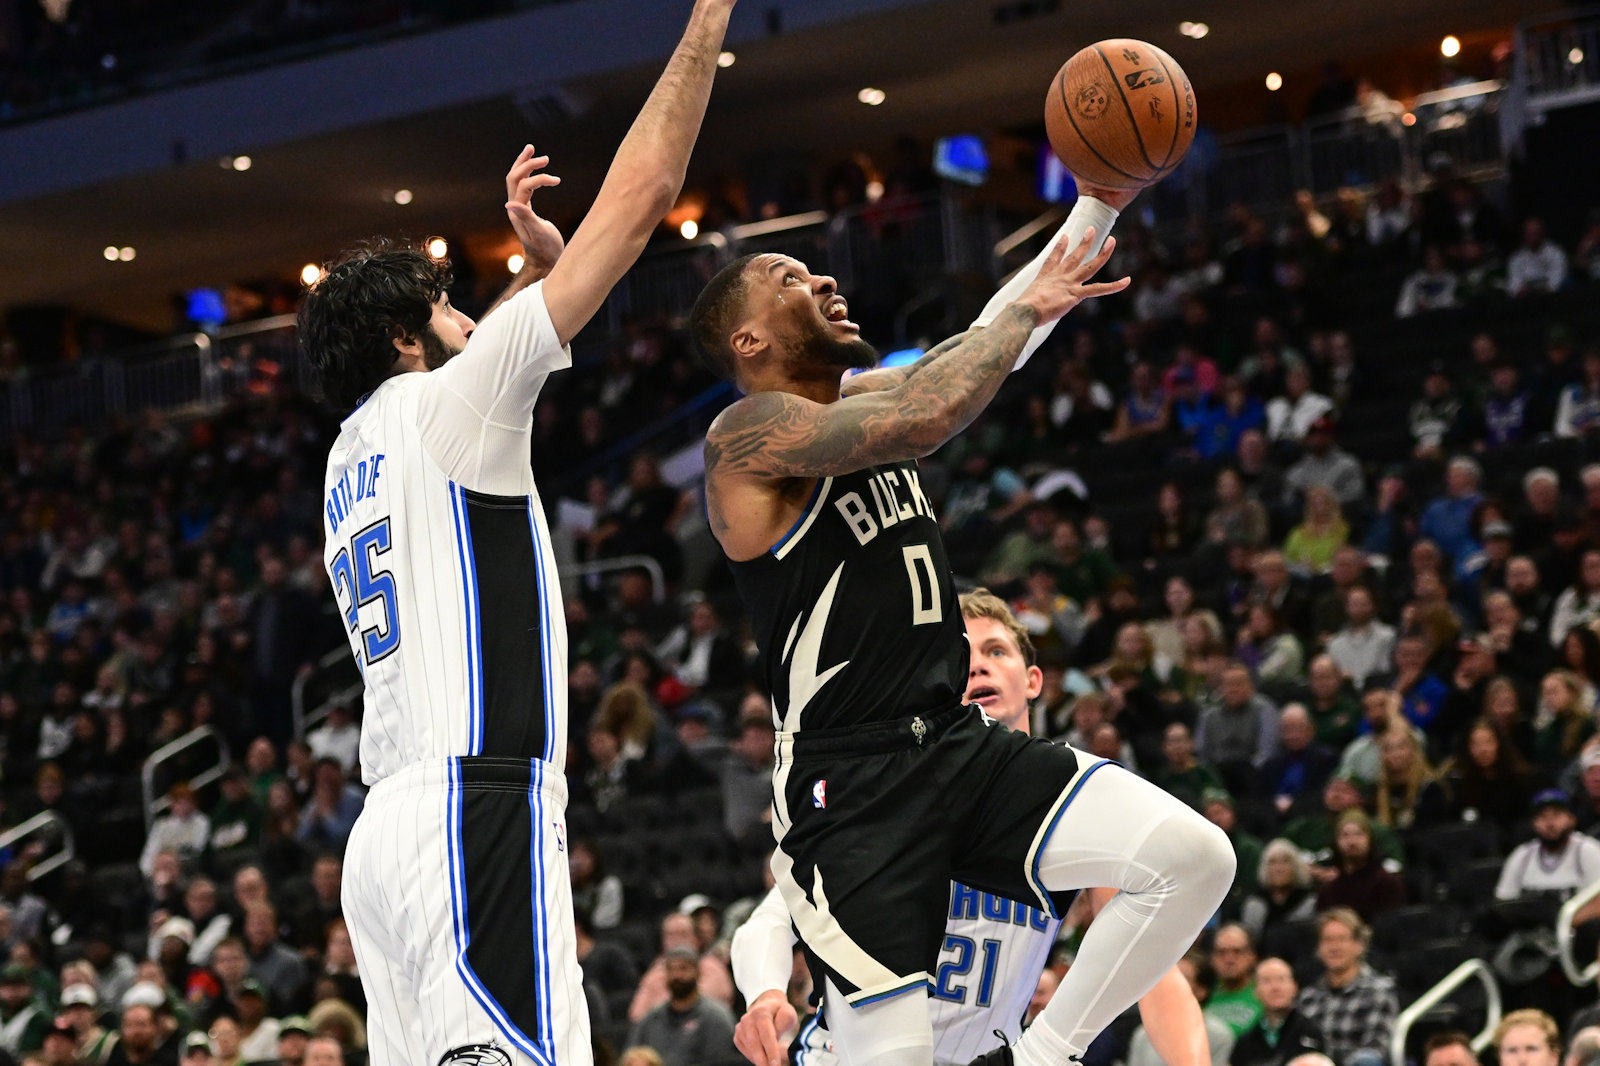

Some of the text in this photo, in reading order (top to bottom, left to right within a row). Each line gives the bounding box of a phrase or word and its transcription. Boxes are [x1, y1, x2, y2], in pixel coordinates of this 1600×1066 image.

[834, 468, 937, 546] BUCK
[902, 544, 943, 626] 0
[935, 933, 1002, 1008] 21
